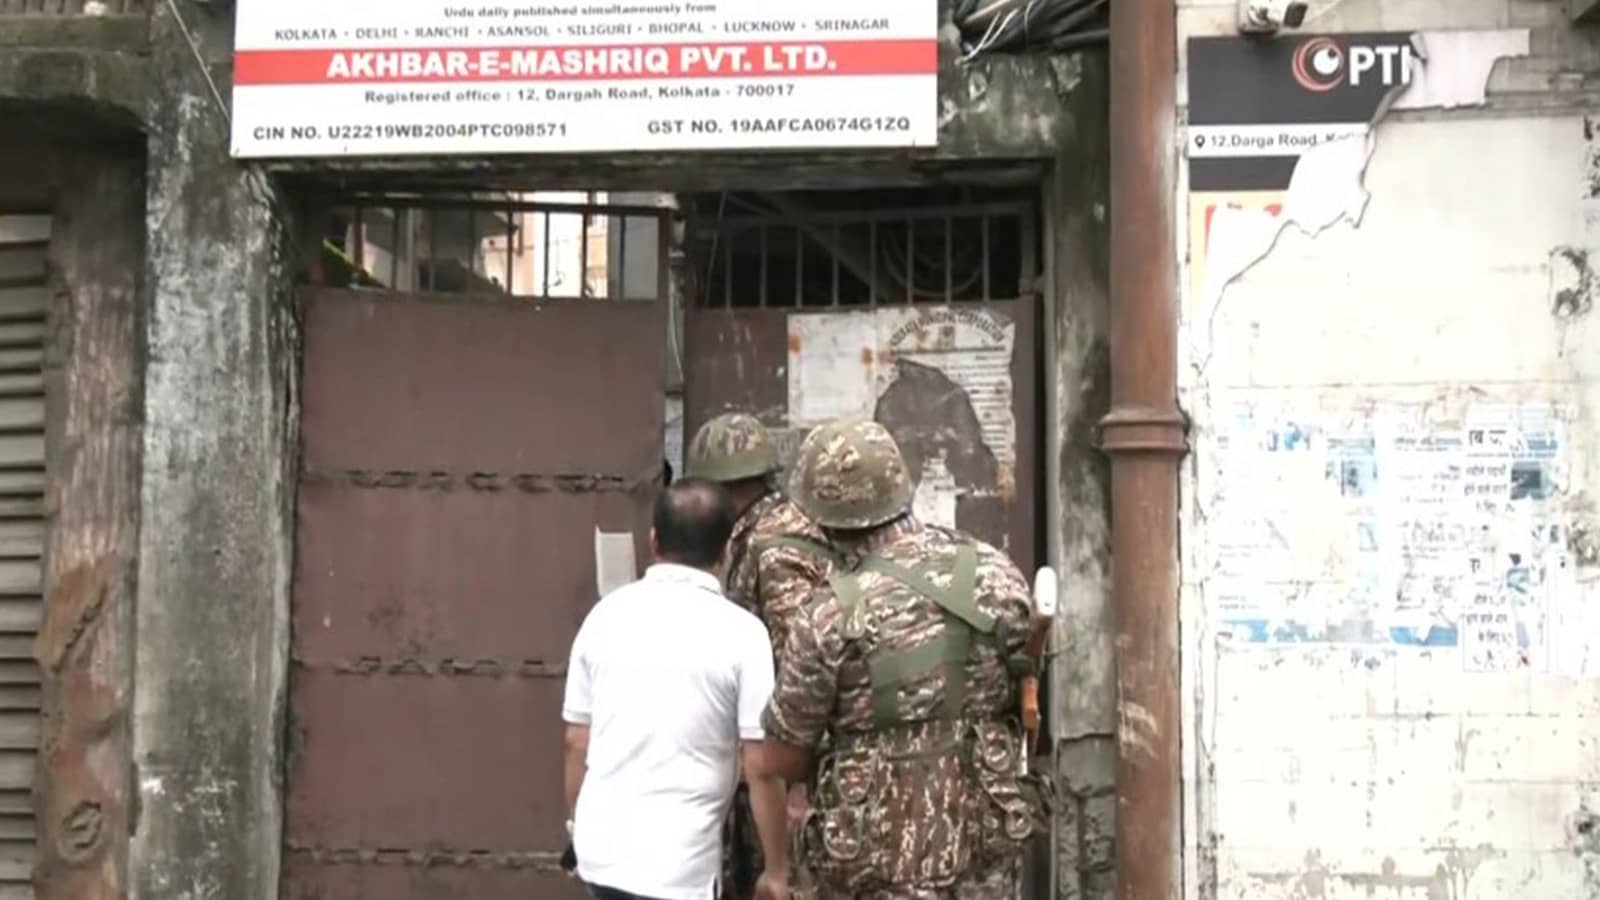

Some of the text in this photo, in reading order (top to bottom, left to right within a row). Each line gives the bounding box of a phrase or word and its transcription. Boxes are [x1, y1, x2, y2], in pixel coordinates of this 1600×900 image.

[444, 3, 717, 19] Urdu daily published simultaneously from
[275, 18, 889, 41] KOLKATA DELHI RANCHI ASANSOL SILIGURI BHOPAL LUCKNOW SRINAGAR
[327, 45, 837, 78] AKHBAR-E-MASHRIQ PVT. LTD.
[364, 90, 451, 105] Registered
[455, 89, 501, 102] office
[517, 88, 541, 103] 12,
[545, 87, 602, 104] Dargah
[608, 86, 653, 101] Road,
[658, 86, 721, 99] Kolkata
[737, 84, 795, 98] 700017
[253, 123, 567, 141] CIN NO. U22219WB2004PTC098571
[647, 119, 684, 134] GST
[691, 119, 723, 133] NO.
